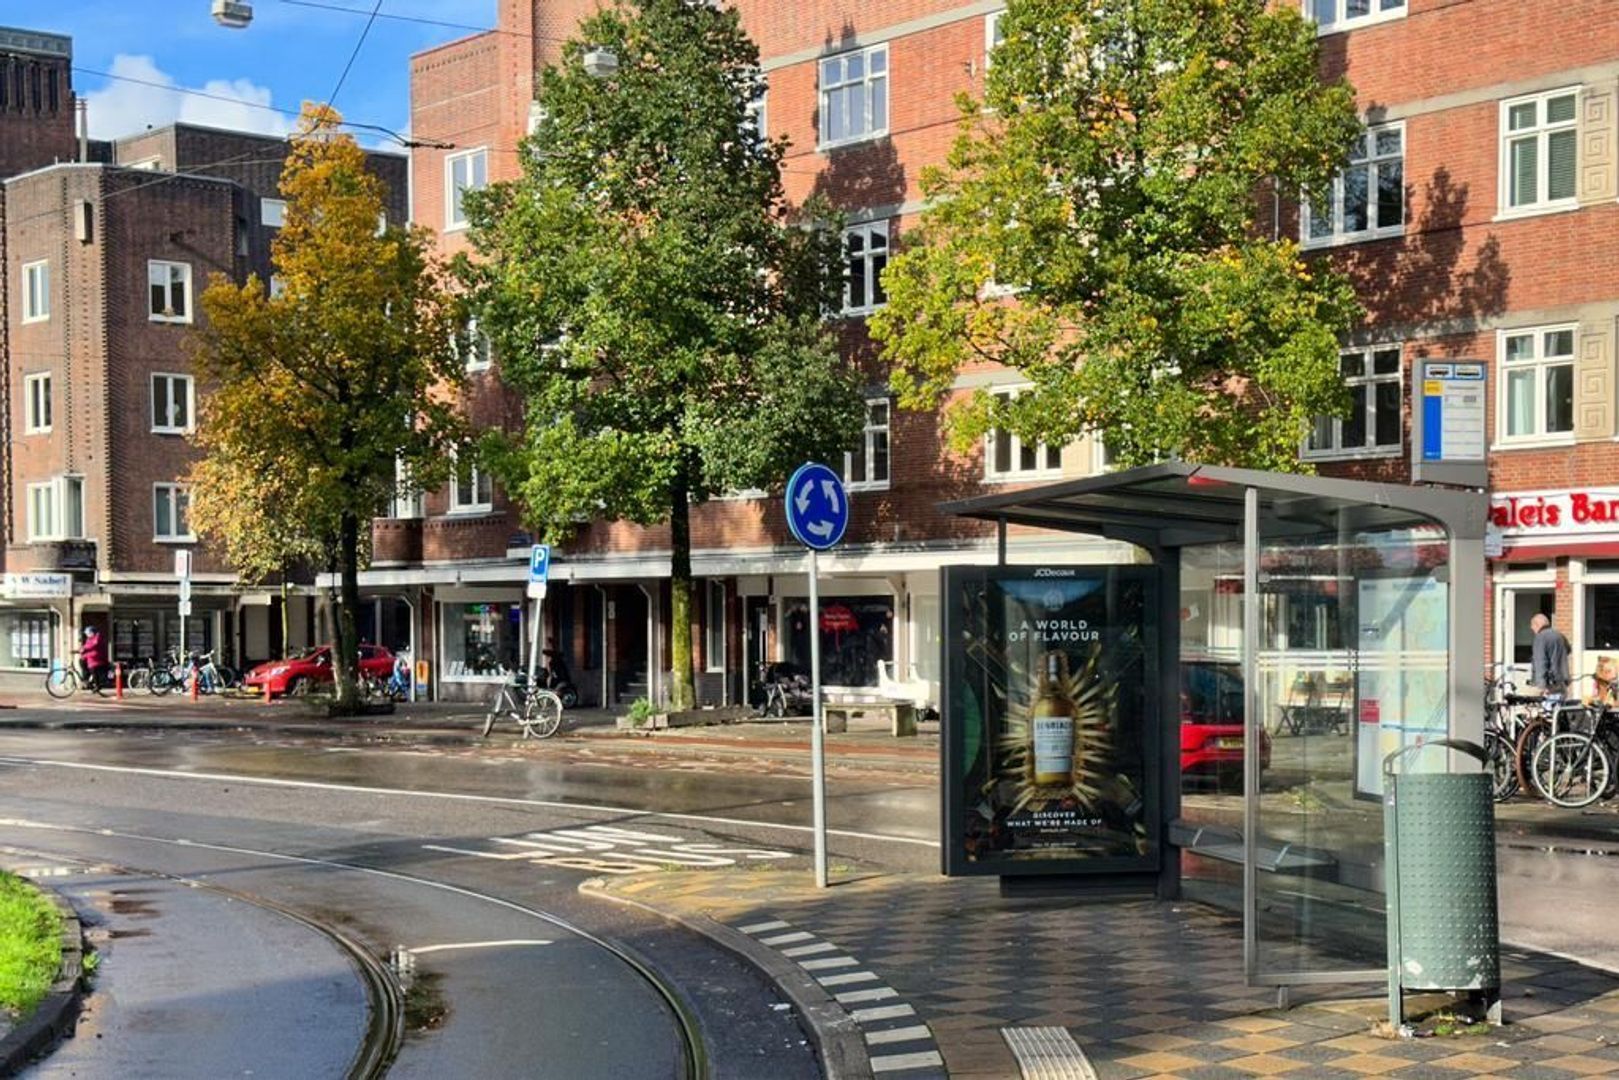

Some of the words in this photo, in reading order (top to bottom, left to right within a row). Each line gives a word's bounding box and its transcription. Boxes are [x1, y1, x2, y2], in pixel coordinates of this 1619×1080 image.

[1488, 496, 1561, 527] aleis
[534, 549, 545, 568] P
[1033, 568, 1075, 577] JCDecaux
[1020, 620, 1029, 630] A
[1036, 620, 1088, 630] WORLD
[1008, 632, 1029, 642] OF
[1034, 631, 1099, 641] FLAVOUR
[1033, 811, 1076, 819] DISCOVER
[1007, 820, 1032, 828] WHAT
[1064, 818, 1088, 826] MADE
